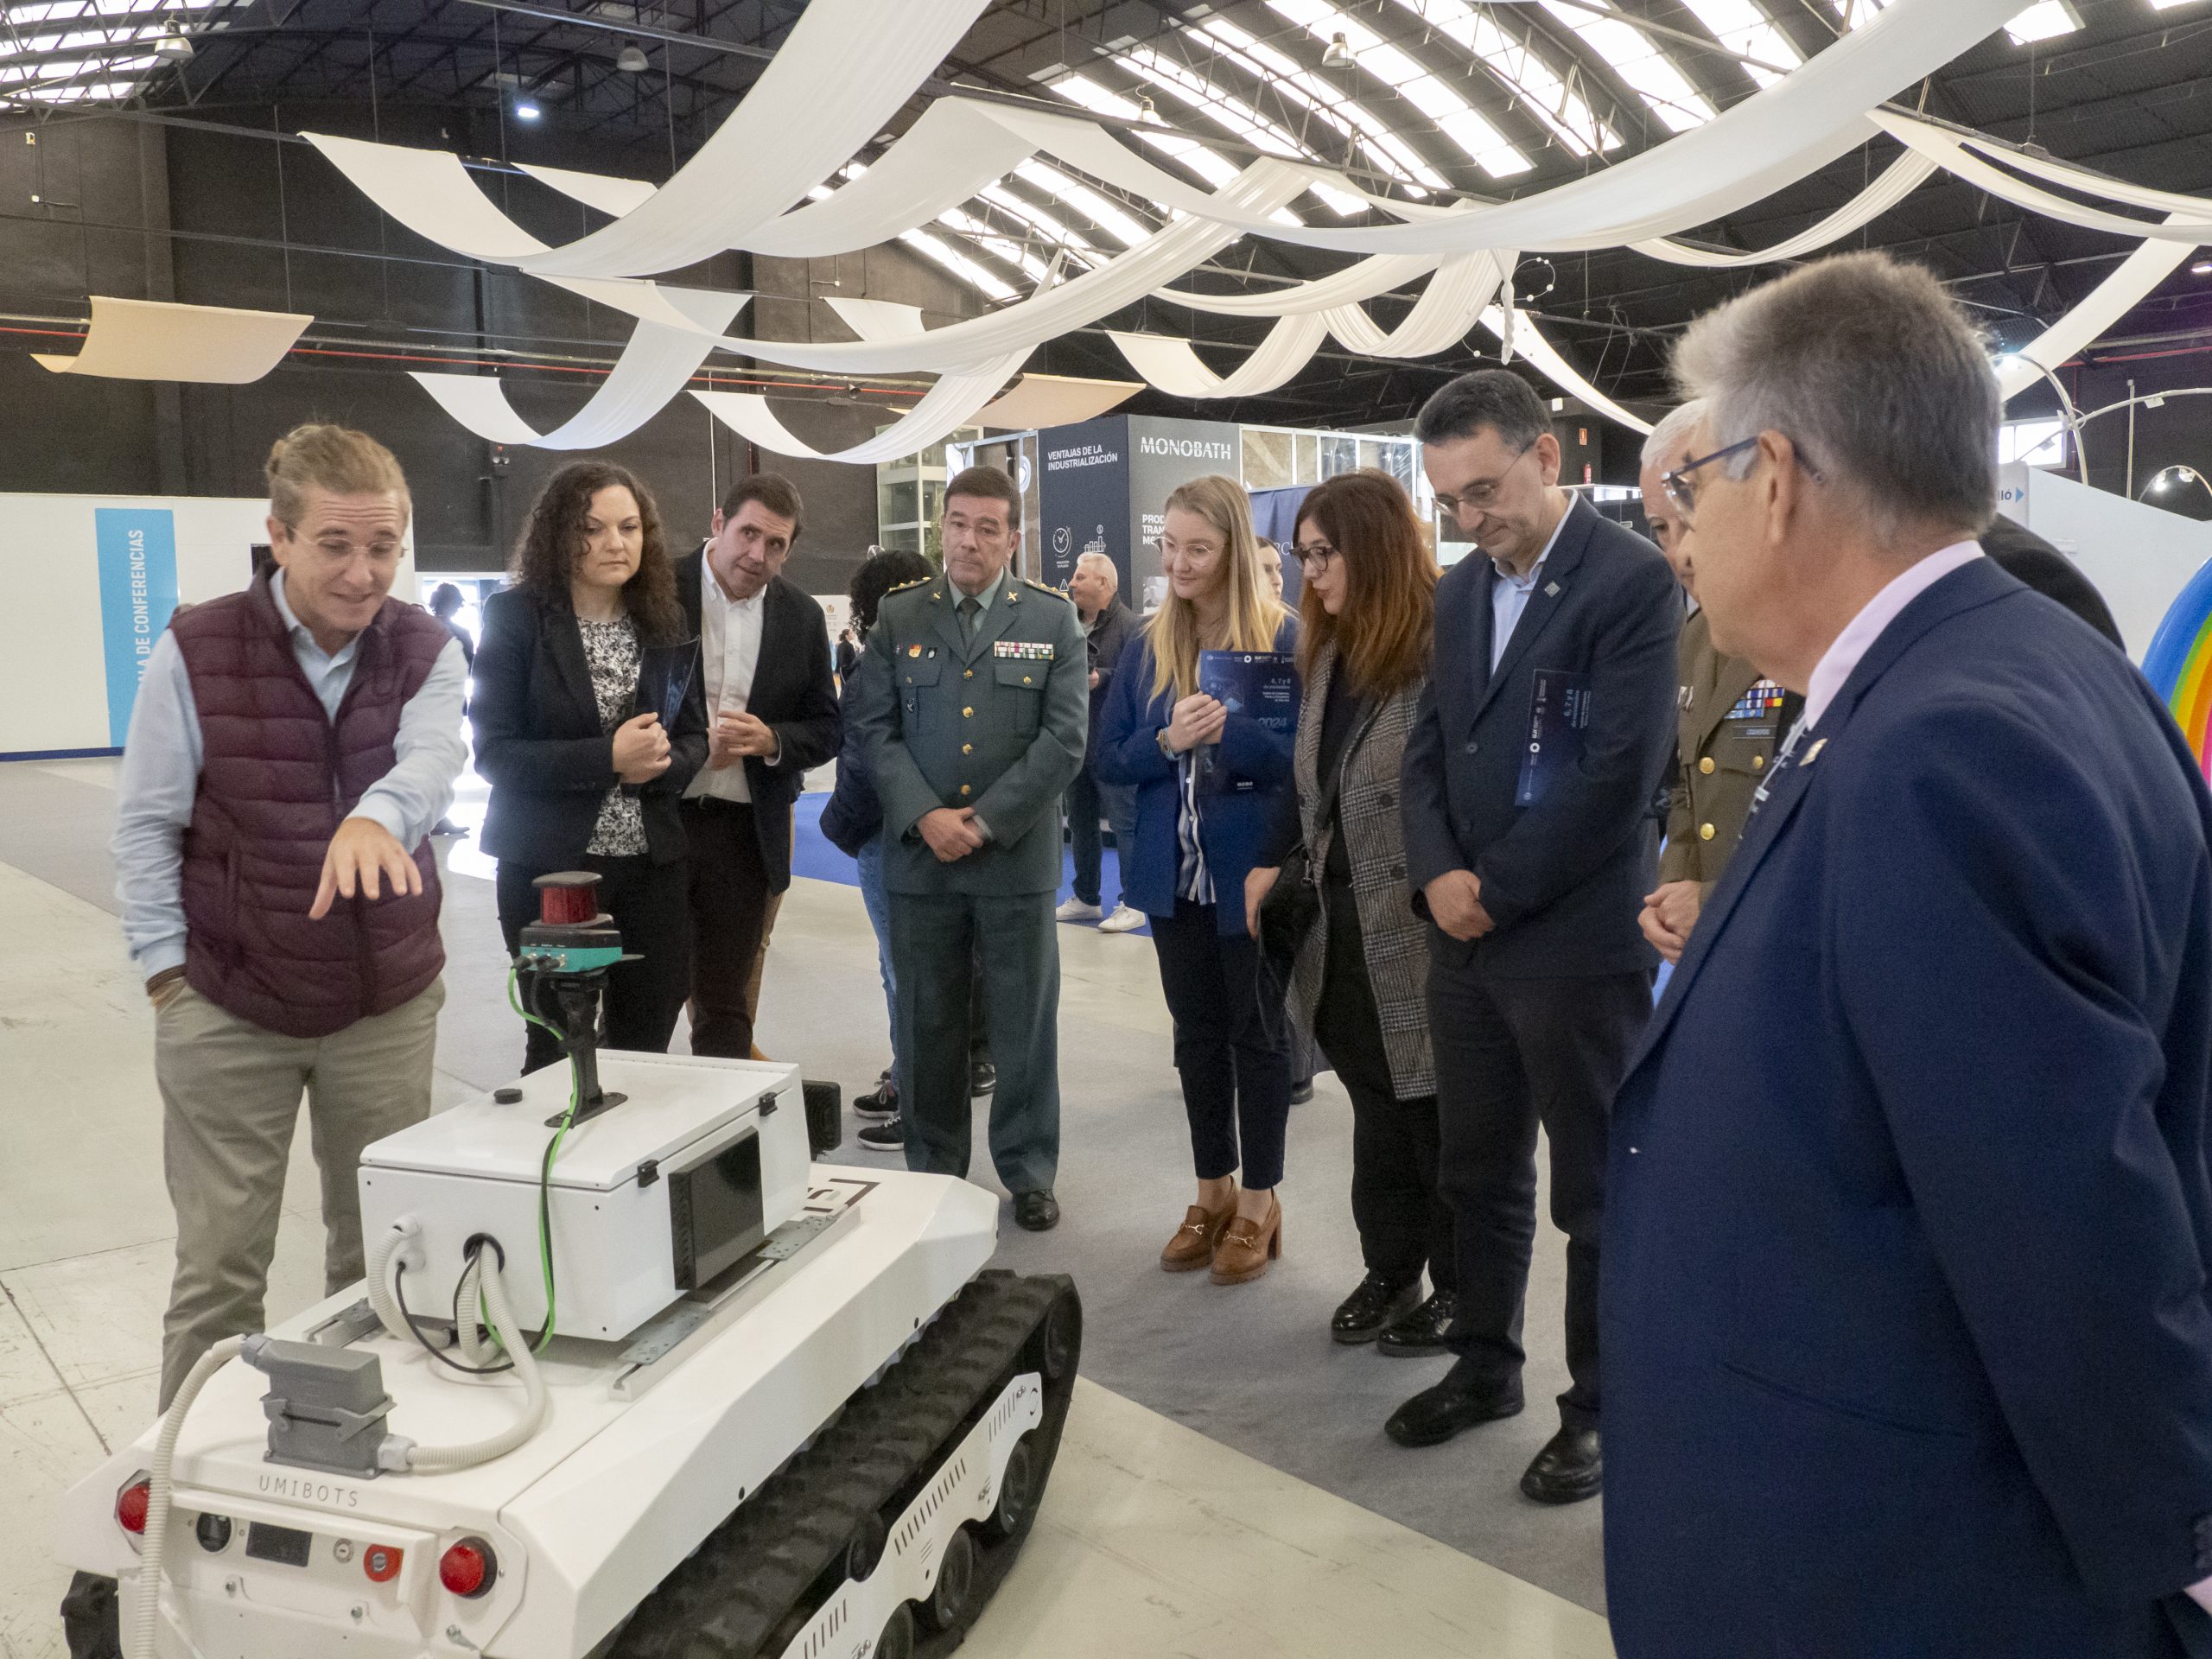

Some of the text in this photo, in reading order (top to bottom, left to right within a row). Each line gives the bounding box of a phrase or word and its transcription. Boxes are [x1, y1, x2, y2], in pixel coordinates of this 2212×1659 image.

[1047, 444, 1103, 461] VENTAJAS DE LA
[1140, 436, 1231, 460] MONOBATH
[1047, 452, 1118, 471] INDUSTRIALIZACIÓN
[129, 530, 149, 633] CONFERENCIAS
[136, 637, 151, 654] DE
[258, 1474, 359, 1508] UMIBOTS
